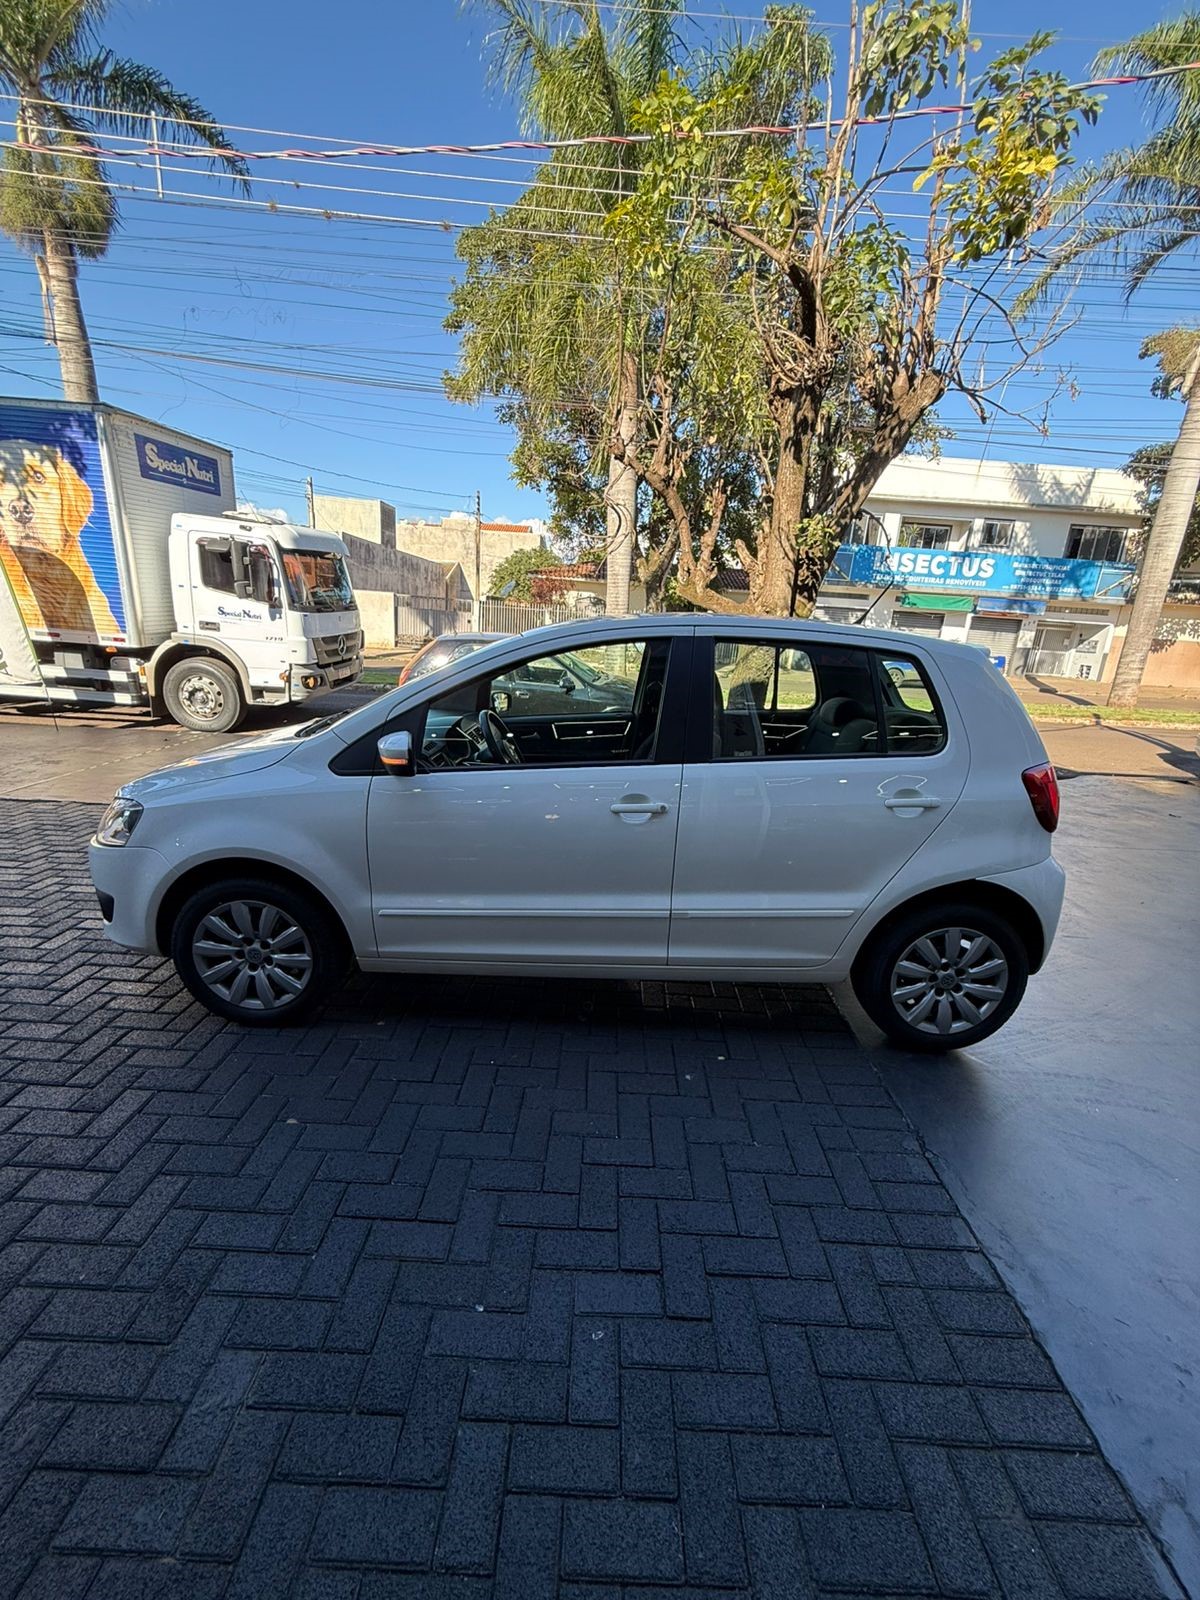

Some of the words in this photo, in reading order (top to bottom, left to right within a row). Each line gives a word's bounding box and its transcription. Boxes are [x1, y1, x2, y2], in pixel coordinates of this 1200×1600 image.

[145, 442, 186, 476] Special
[185, 456, 215, 484] Nutri
[873, 551, 996, 579] INSECTUS
[217, 606, 242, 617] Special
[242, 609, 262, 620] Nutri
